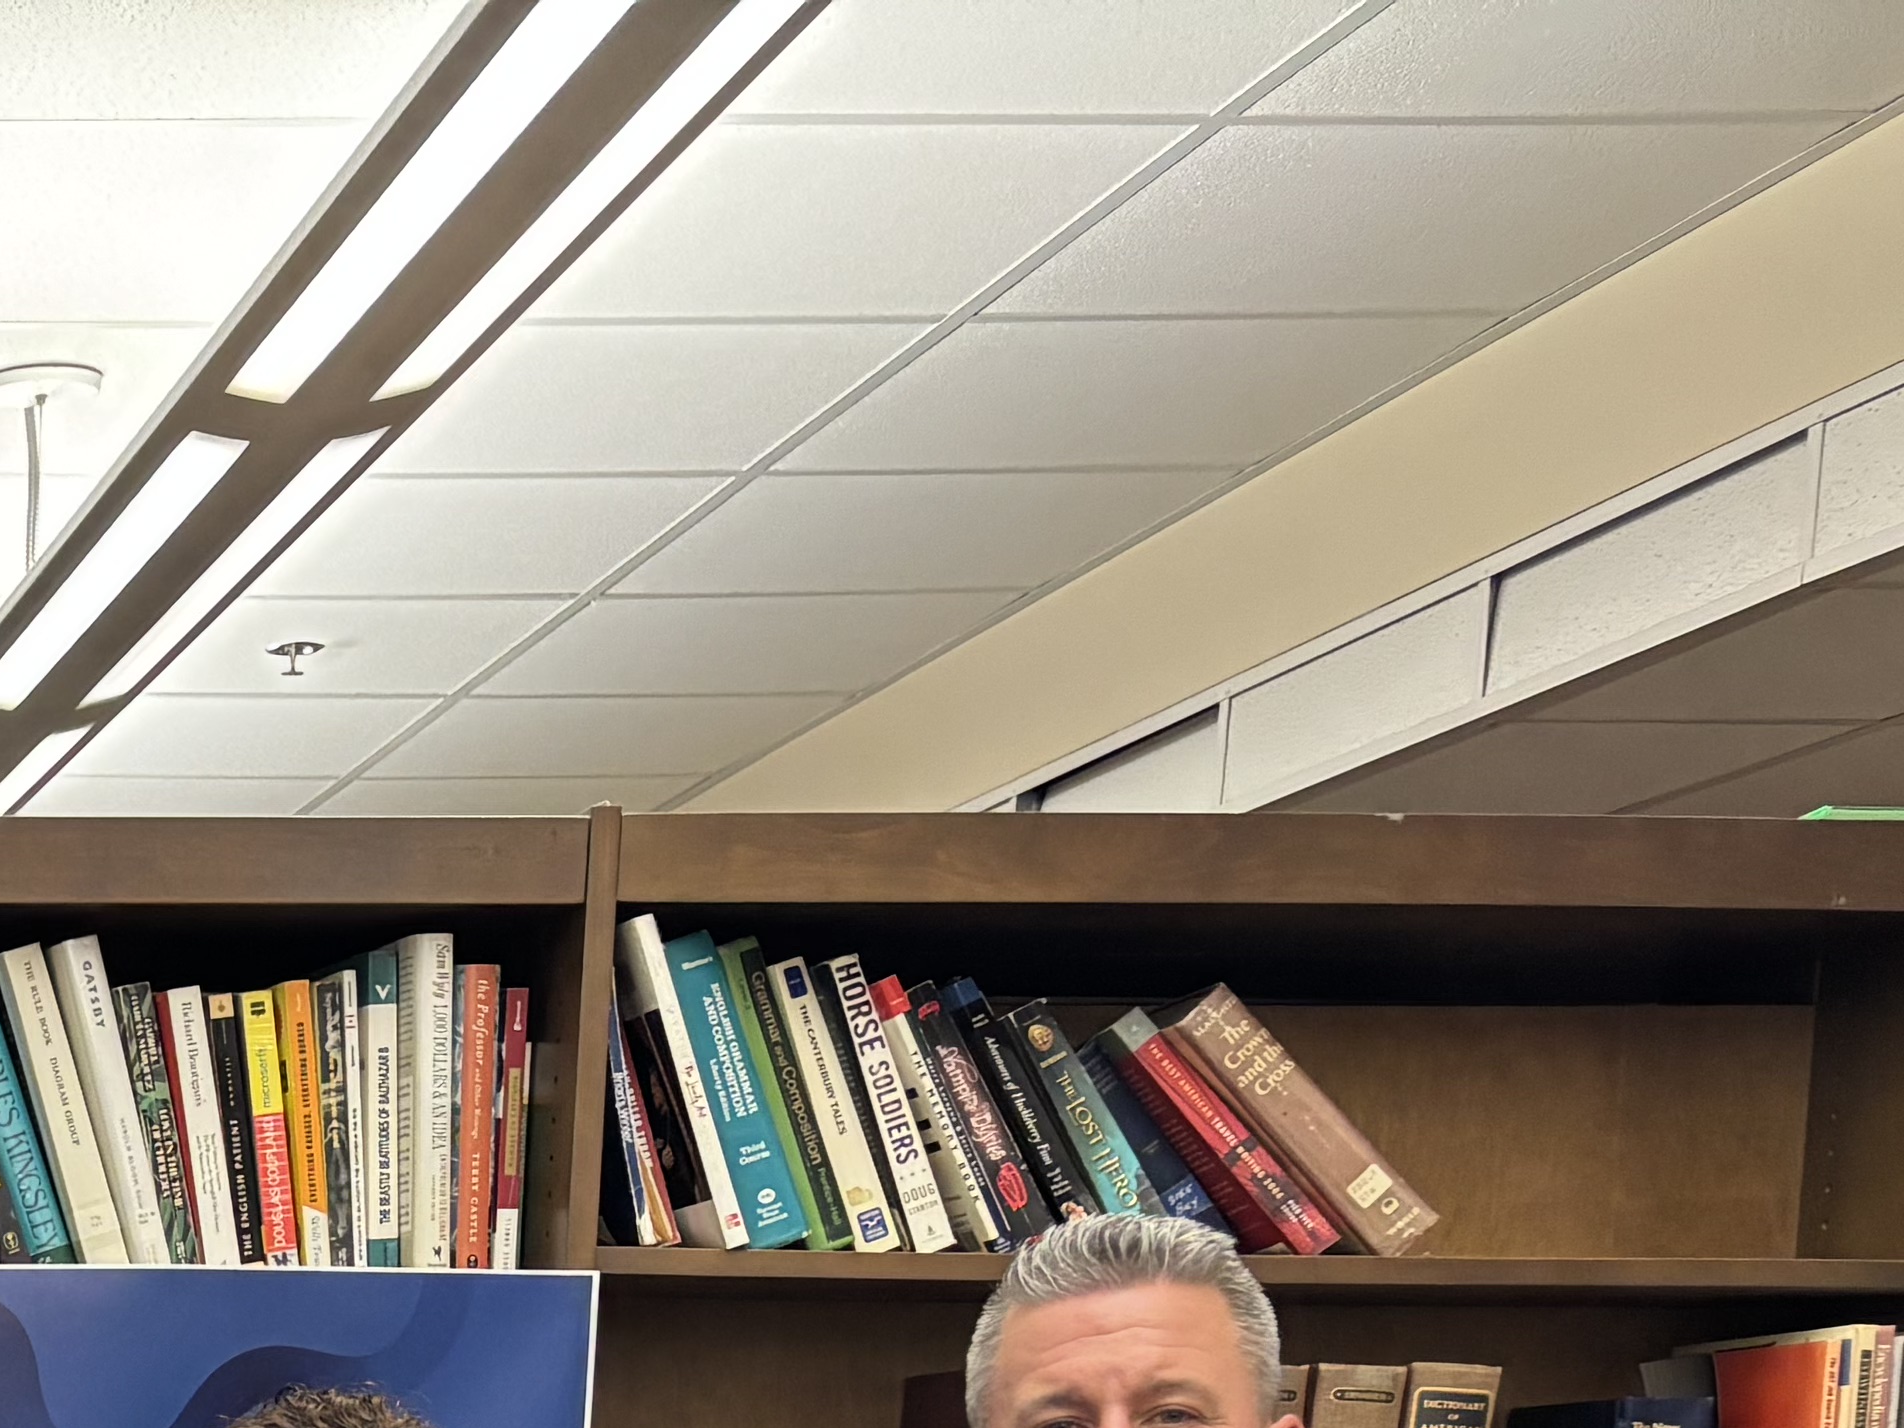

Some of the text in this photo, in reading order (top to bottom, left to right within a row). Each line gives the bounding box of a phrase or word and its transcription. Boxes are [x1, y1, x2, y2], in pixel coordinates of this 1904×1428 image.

[82, 960, 106, 1029] GATSBY
[1219, 1020, 1250, 1045] The
[430, 1003, 449, 1148] 1,000 DOLLARS AN IDEA
[468, 1001, 489, 1243] Professor TERRY CASTLE
[751, 970, 822, 1167] Grammar Composition
[798, 1004, 848, 1135] THE CANTERBURY TALES
[835, 961, 919, 1165] HORSE SOLDIERS
[1178, 1078, 1239, 1148] AMERICAN TRAVEL
[1254, 1059, 1295, 1096] Cross
[3, 1131, 62, 1250] KINGSLEY
[229, 1119, 252, 1256] THE ENGLISH PATIENT
[378, 1104, 391, 1225] THE BEASTLY BEATITUDES OF
[902, 1183, 936, 1203] DOUG
[1065, 1097, 1138, 1208] LOST HERO
